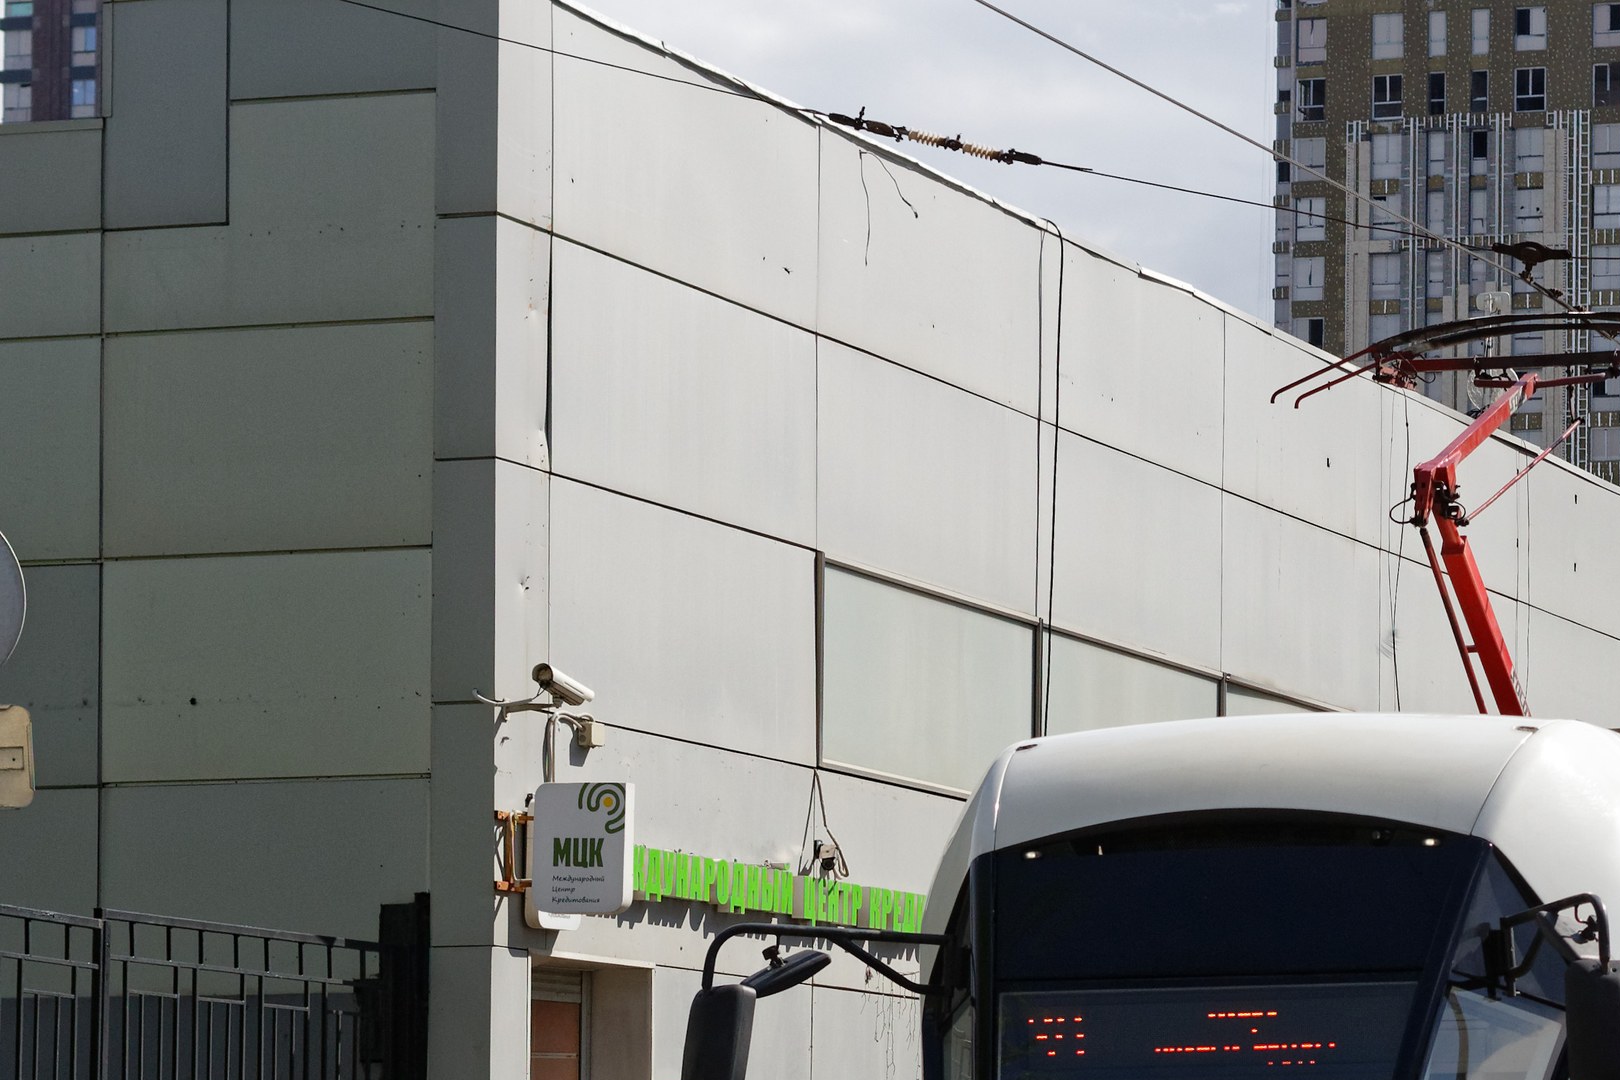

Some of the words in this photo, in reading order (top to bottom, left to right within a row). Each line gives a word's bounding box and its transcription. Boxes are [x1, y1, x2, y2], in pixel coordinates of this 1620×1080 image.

[552, 837, 605, 868] МЦК
[551, 874, 605, 884] Международный
[551, 886, 576, 894] Центр
[551, 896, 600, 904] Кредитования
[804, 875, 863, 927] ЦЕНТР
